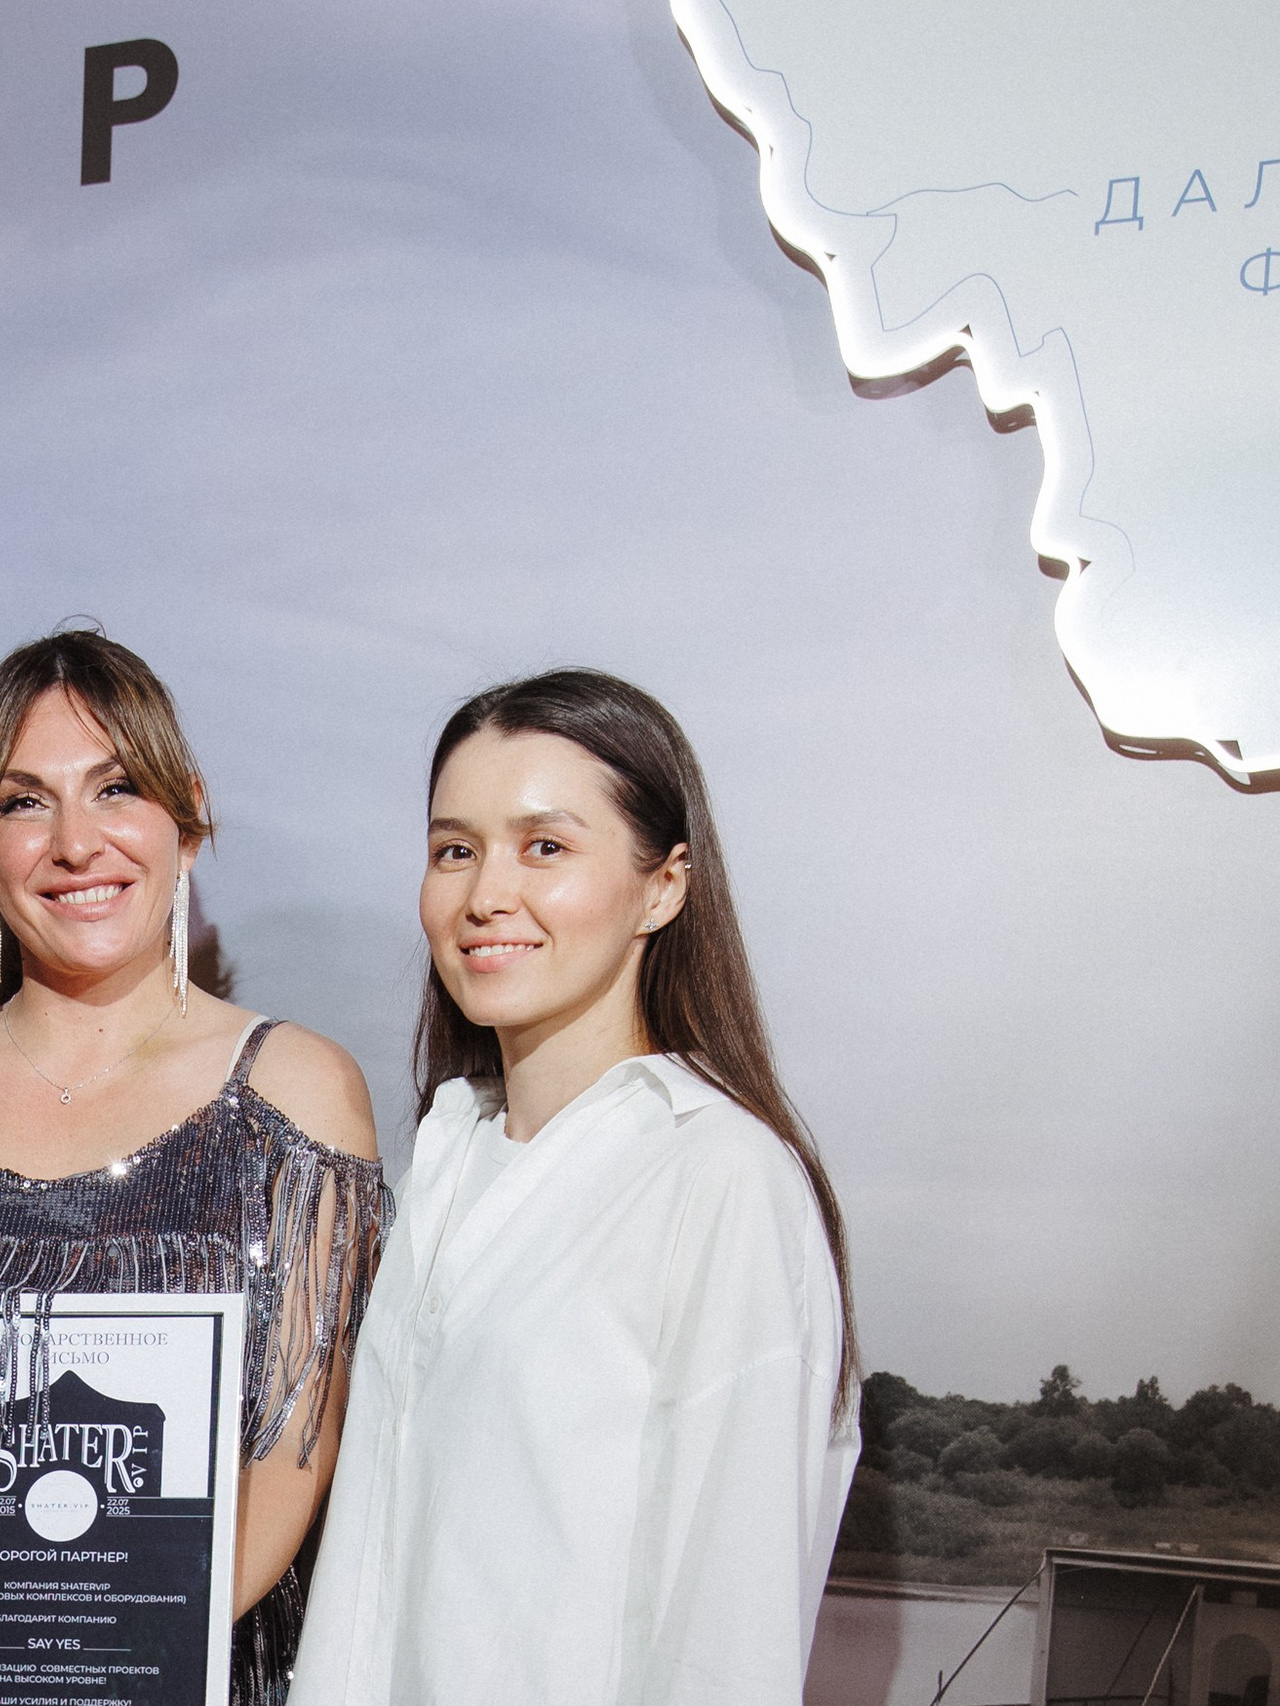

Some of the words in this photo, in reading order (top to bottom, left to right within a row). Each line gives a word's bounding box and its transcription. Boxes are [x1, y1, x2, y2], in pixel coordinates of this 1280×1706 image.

[107, 1498, 129, 1506] 22.07
[106, 1506, 131, 1515] 2025
[60, 1551, 129, 1563] ПАРТНЕР!
[4, 1581, 59, 1591] КОМПАНИЯ
[60, 1582, 111, 1591] SHATERVIP
[26, 1593, 93, 1602] КОМПЛЕКСОВ
[94, 1594, 102, 1602] И
[103, 1593, 187, 1604] ОБОРУДОВАНИЯ)
[57, 1614, 117, 1624] КОМПАНИЮ
[27, 1638, 54, 1649] SAY
[55, 1639, 81, 1650] YES
[40, 1664, 107, 1674] СОВМЕСТНЫХ
[108, 1665, 160, 1675] ПРОЕКТОВ
[14, 1675, 64, 1684] ВЫСОКОМ
[65, 1676, 107, 1685] УРОВНЕ!
[19, 1697, 58, 1706] УСИЛИЯ
[60, 1698, 68, 1706] И
